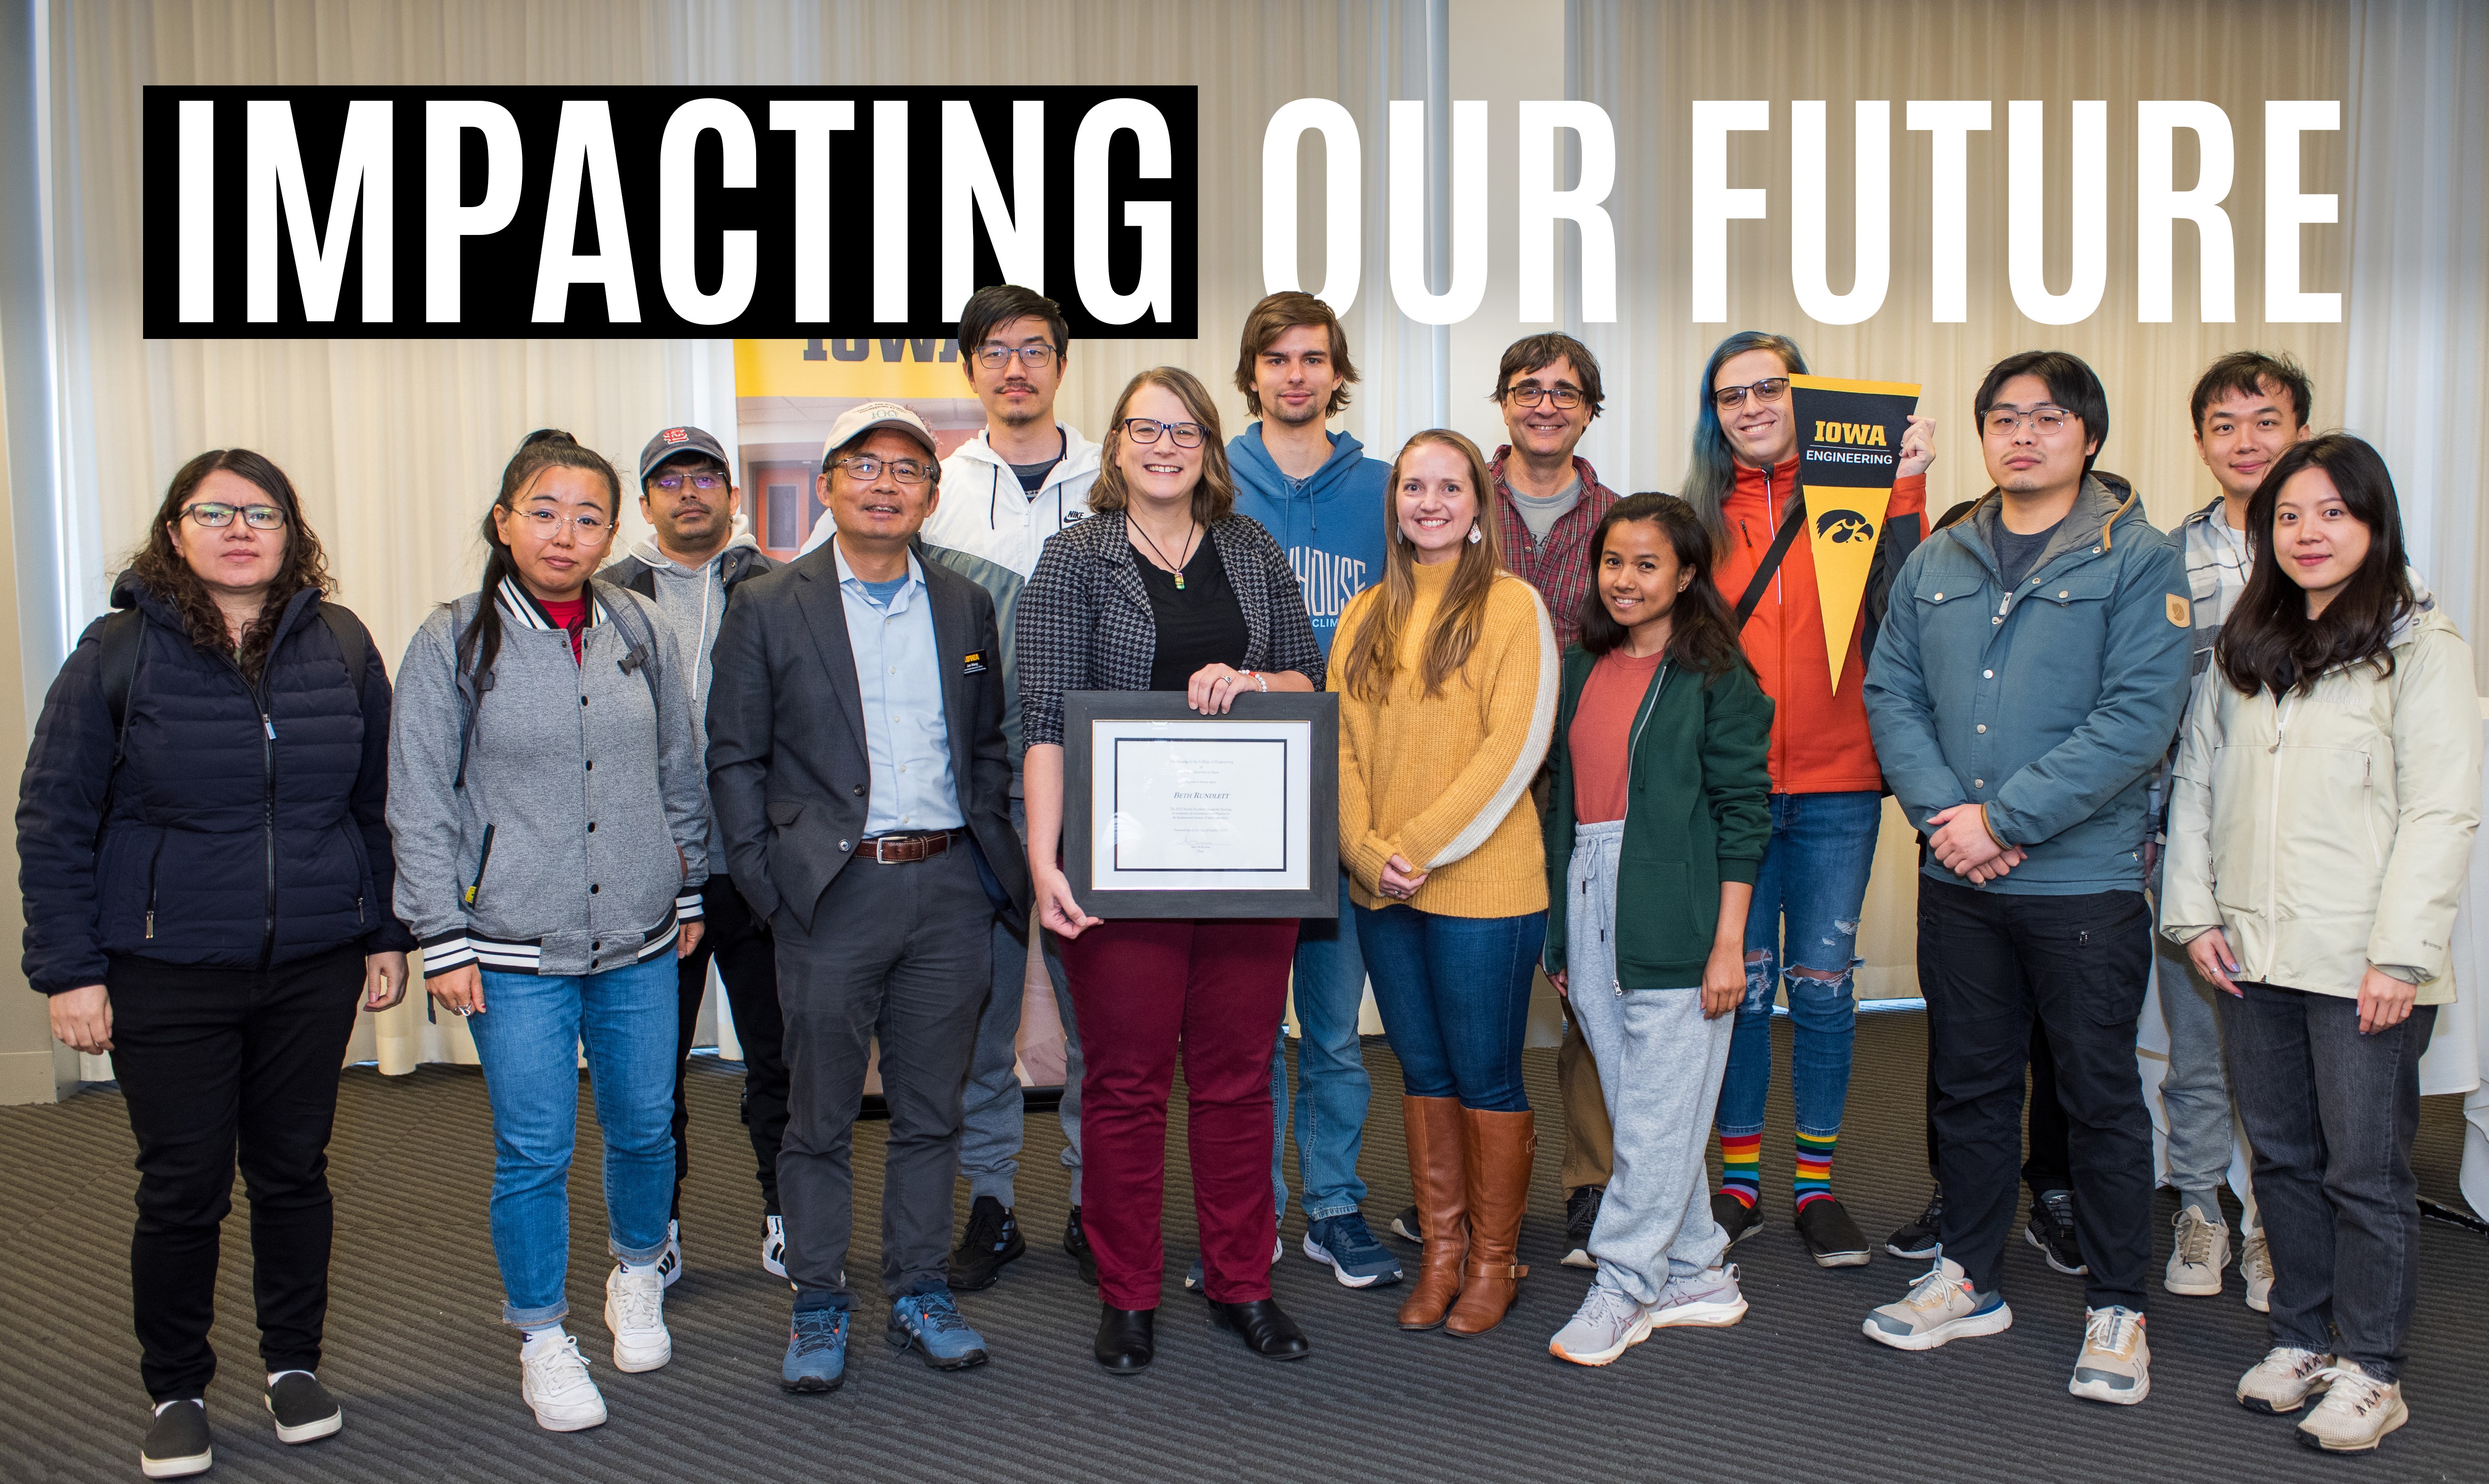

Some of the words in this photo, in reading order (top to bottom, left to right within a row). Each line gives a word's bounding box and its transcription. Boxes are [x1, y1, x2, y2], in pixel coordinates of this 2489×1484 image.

[1814, 421, 1887, 447] IOWA
[1806, 449, 1893, 465] ENGINEERING
[1068, 510, 1084, 519] NIKE
